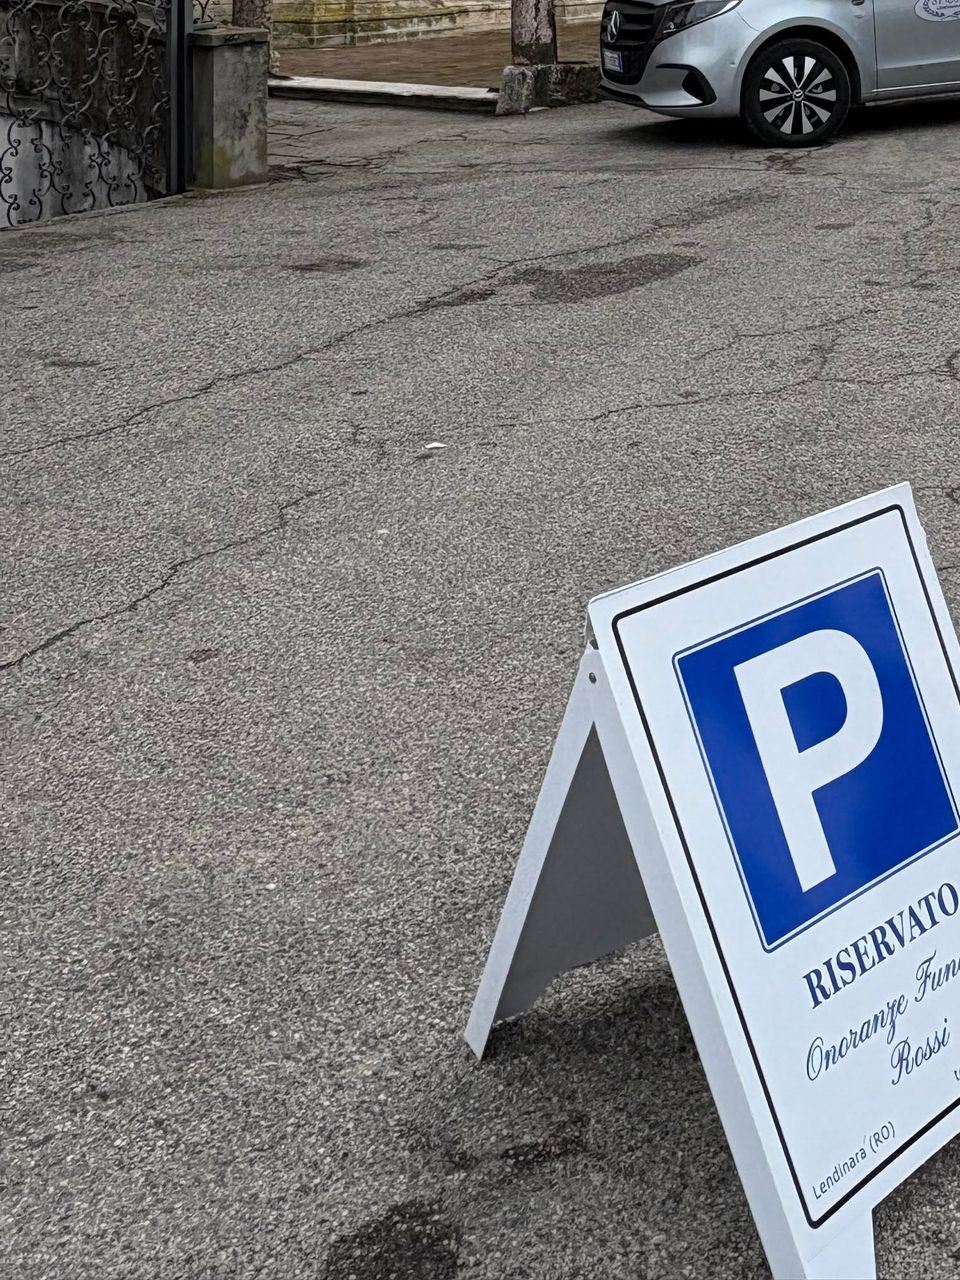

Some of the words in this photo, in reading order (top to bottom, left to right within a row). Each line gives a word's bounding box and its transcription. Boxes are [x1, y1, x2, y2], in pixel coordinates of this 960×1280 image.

[733, 628, 884, 893] P
[802, 882, 960, 1010] RISERVATO
[806, 994, 909, 1081] Onoranze
[890, 1018, 951, 1086] Rossi
[869, 1120, 895, 1154] (RO)
